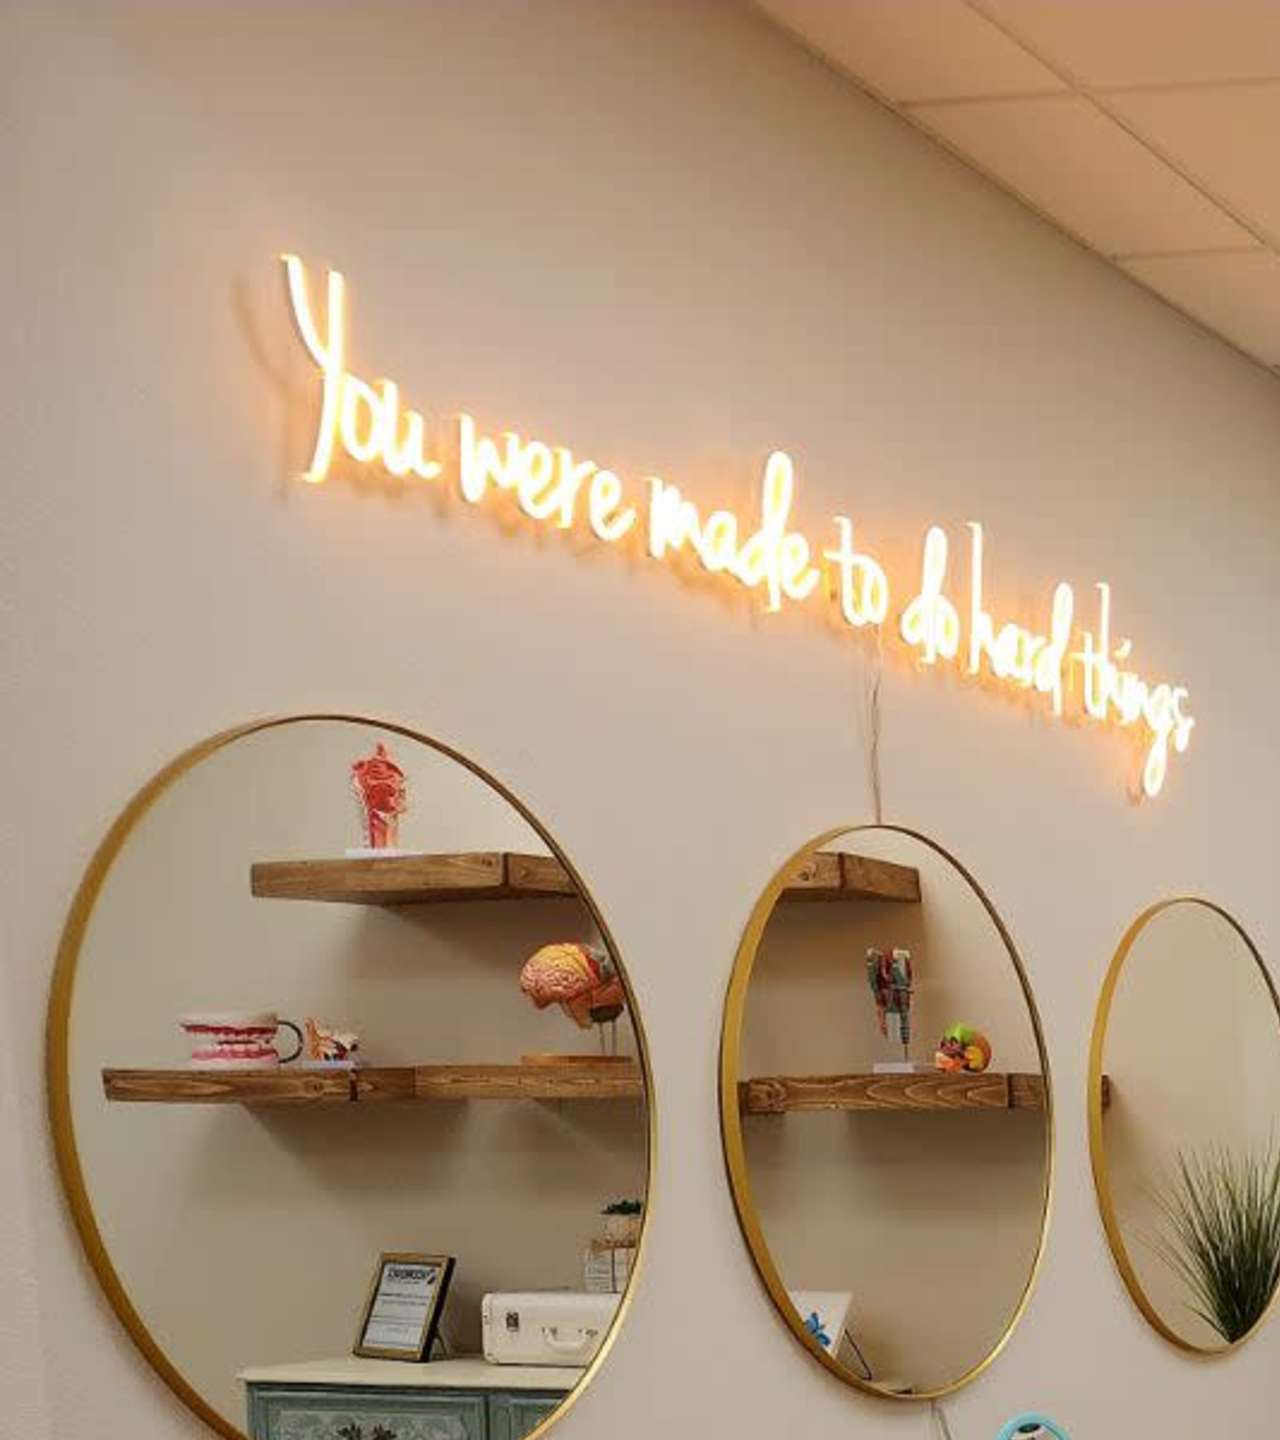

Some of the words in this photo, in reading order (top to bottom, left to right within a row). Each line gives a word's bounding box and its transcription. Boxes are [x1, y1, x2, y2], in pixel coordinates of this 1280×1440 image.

[281, 253, 440, 483] You
[458, 411, 636, 542] were
[649, 450, 820, 612] made
[823, 515, 890, 627] to
[899, 525, 960, 664] do
[966, 521, 1074, 716] hard
[1074, 581, 1196, 797] things
